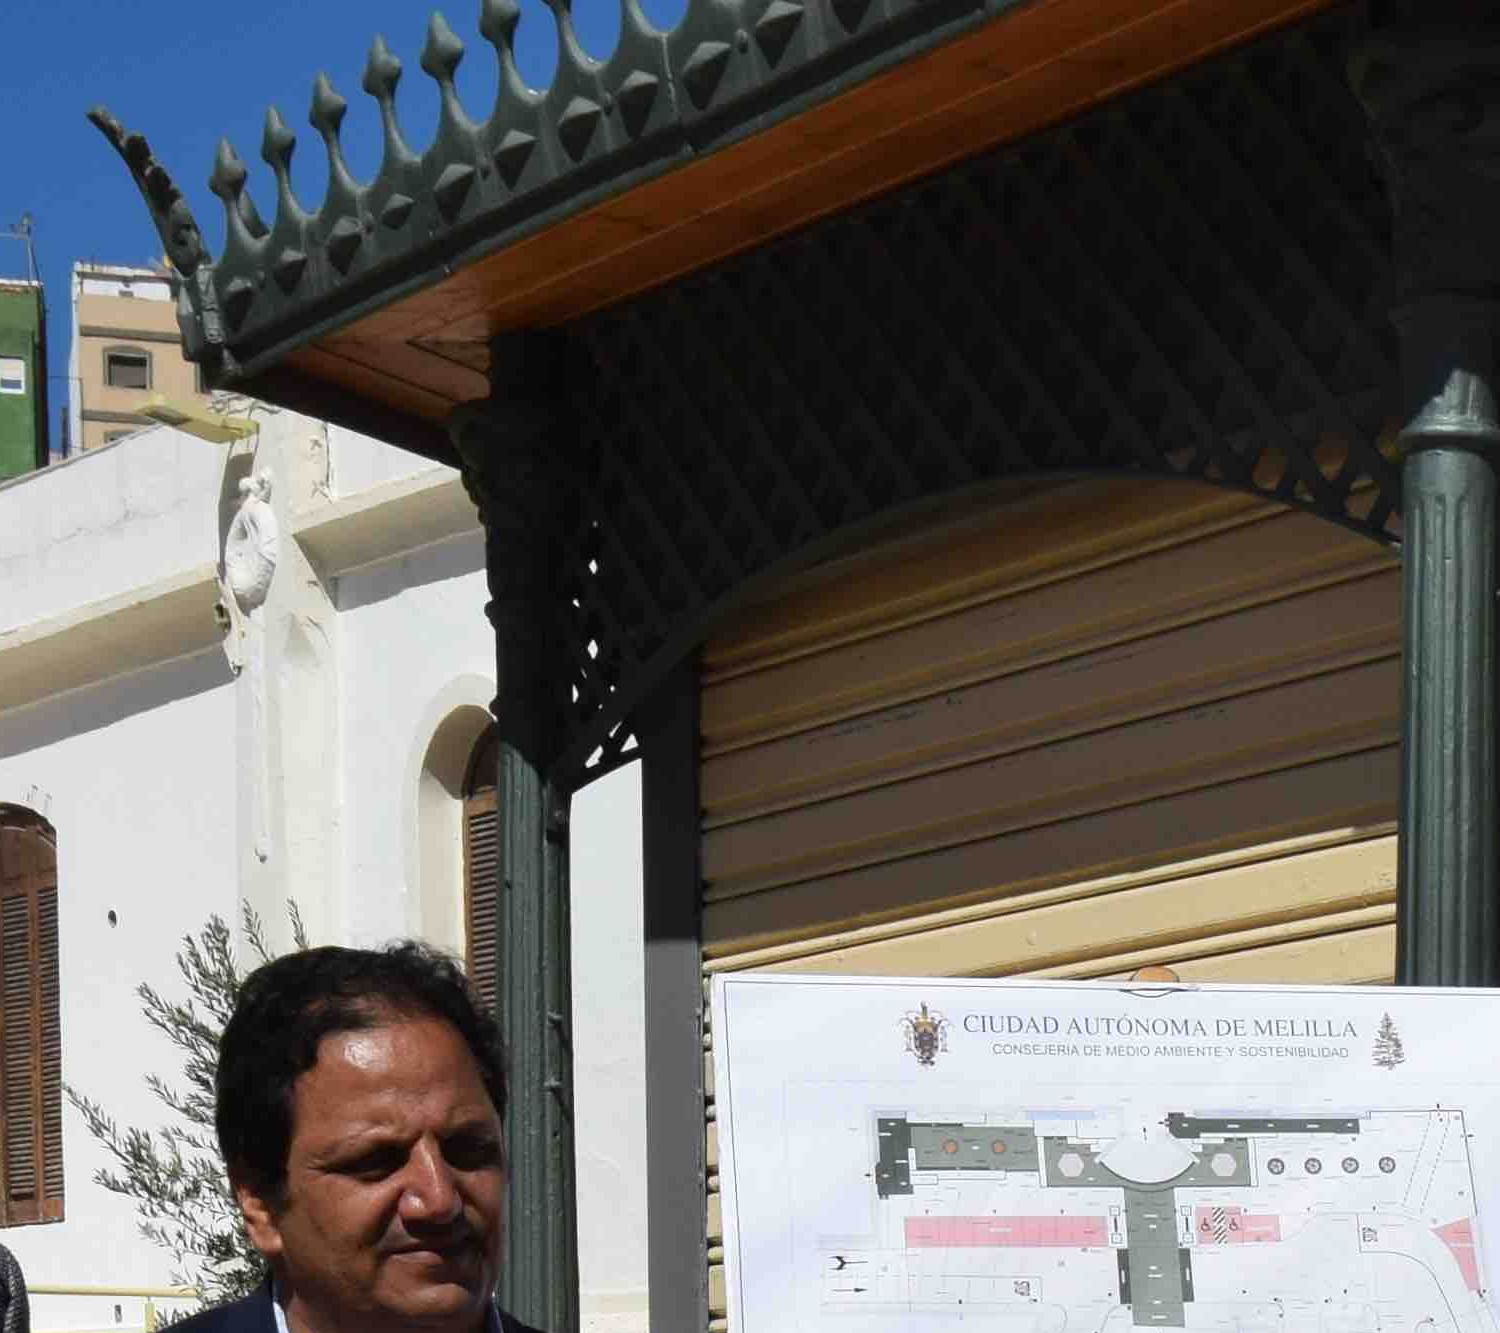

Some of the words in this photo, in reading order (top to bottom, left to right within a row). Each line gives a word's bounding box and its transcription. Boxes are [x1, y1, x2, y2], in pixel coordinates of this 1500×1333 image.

[963, 1014, 1059, 1034] CIUDAD
[1067, 1013, 1207, 1036] AUTÓNOMA
[1216, 1018, 1246, 1037] DE
[1254, 1019, 1357, 1037] MELILLA
[1083, 1045, 1102, 1057] DE
[1106, 1046, 1150, 1057] MEDIO
[1154, 1046, 1221, 1057] AMBIENTE
[1227, 1047, 1235, 1057] Y
[1239, 1047, 1349, 1058] SOSTENIBILIDAD
